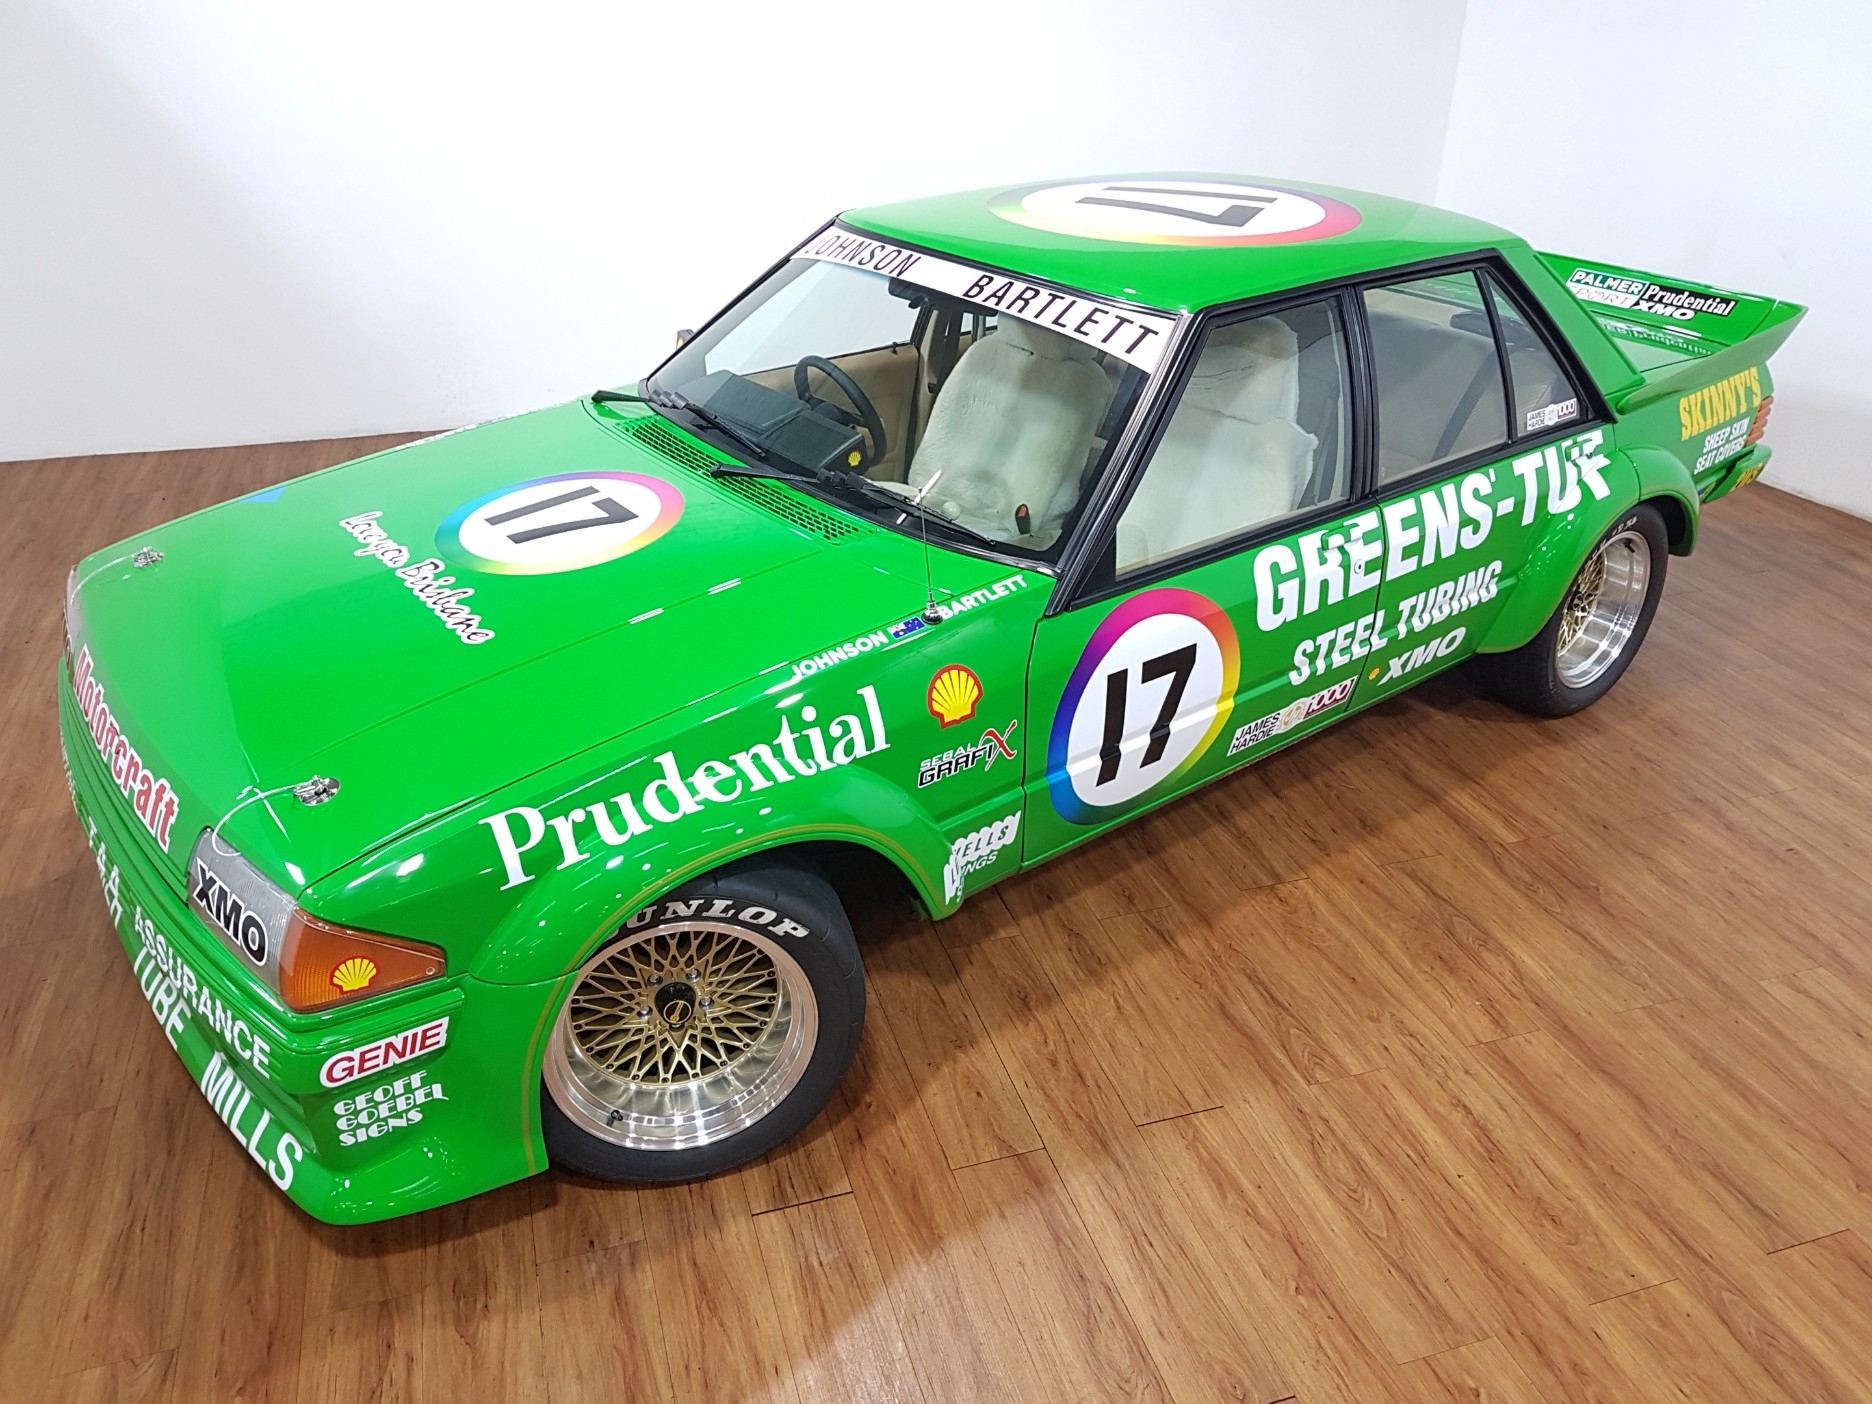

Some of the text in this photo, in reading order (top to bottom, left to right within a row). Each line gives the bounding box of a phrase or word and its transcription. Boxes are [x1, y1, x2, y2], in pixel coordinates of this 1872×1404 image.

[1075, 185, 1278, 228] 17
[806, 233, 1159, 355] JOHNSON BARTLETT
[1571, 271, 1736, 316] PALMER Prudential
[1631, 300, 1696, 321] XMO
[1679, 366, 1761, 441] SKINNY'S
[1694, 434, 1746, 474] SEAT COVERS
[1703, 416, 1750, 453] SHEEP SKIN
[484, 485, 640, 545] 17
[396, 559, 495, 643] Brisbane
[790, 573, 1028, 682] JOHNSON BARTLETT
[1288, 560, 1502, 686] STEEL TUBING
[1377, 627, 1467, 686] XMO
[1095, 642, 1198, 788] 17
[1235, 712, 1281, 741] JAMES
[1304, 679, 1356, 715] 1000
[73, 644, 180, 855] Motorcraft
[918, 720, 1017, 788] GRAFIX
[920, 743, 978, 769] SEBAL
[1229, 724, 1275, 754] HARDIE
[478, 685, 891, 891] Prudential
[193, 857, 267, 966] XMO
[603, 899, 811, 941] UNLOP
[134, 905, 271, 1079] ASSURANCE
[133, 945, 304, 1191] TUBE MILLS
[324, 1021, 444, 1084] GENIE
[334, 1070, 427, 1115] GEOFF
[336, 1083, 449, 1130] GOEBEL
[339, 1108, 423, 1146] SIGNS
